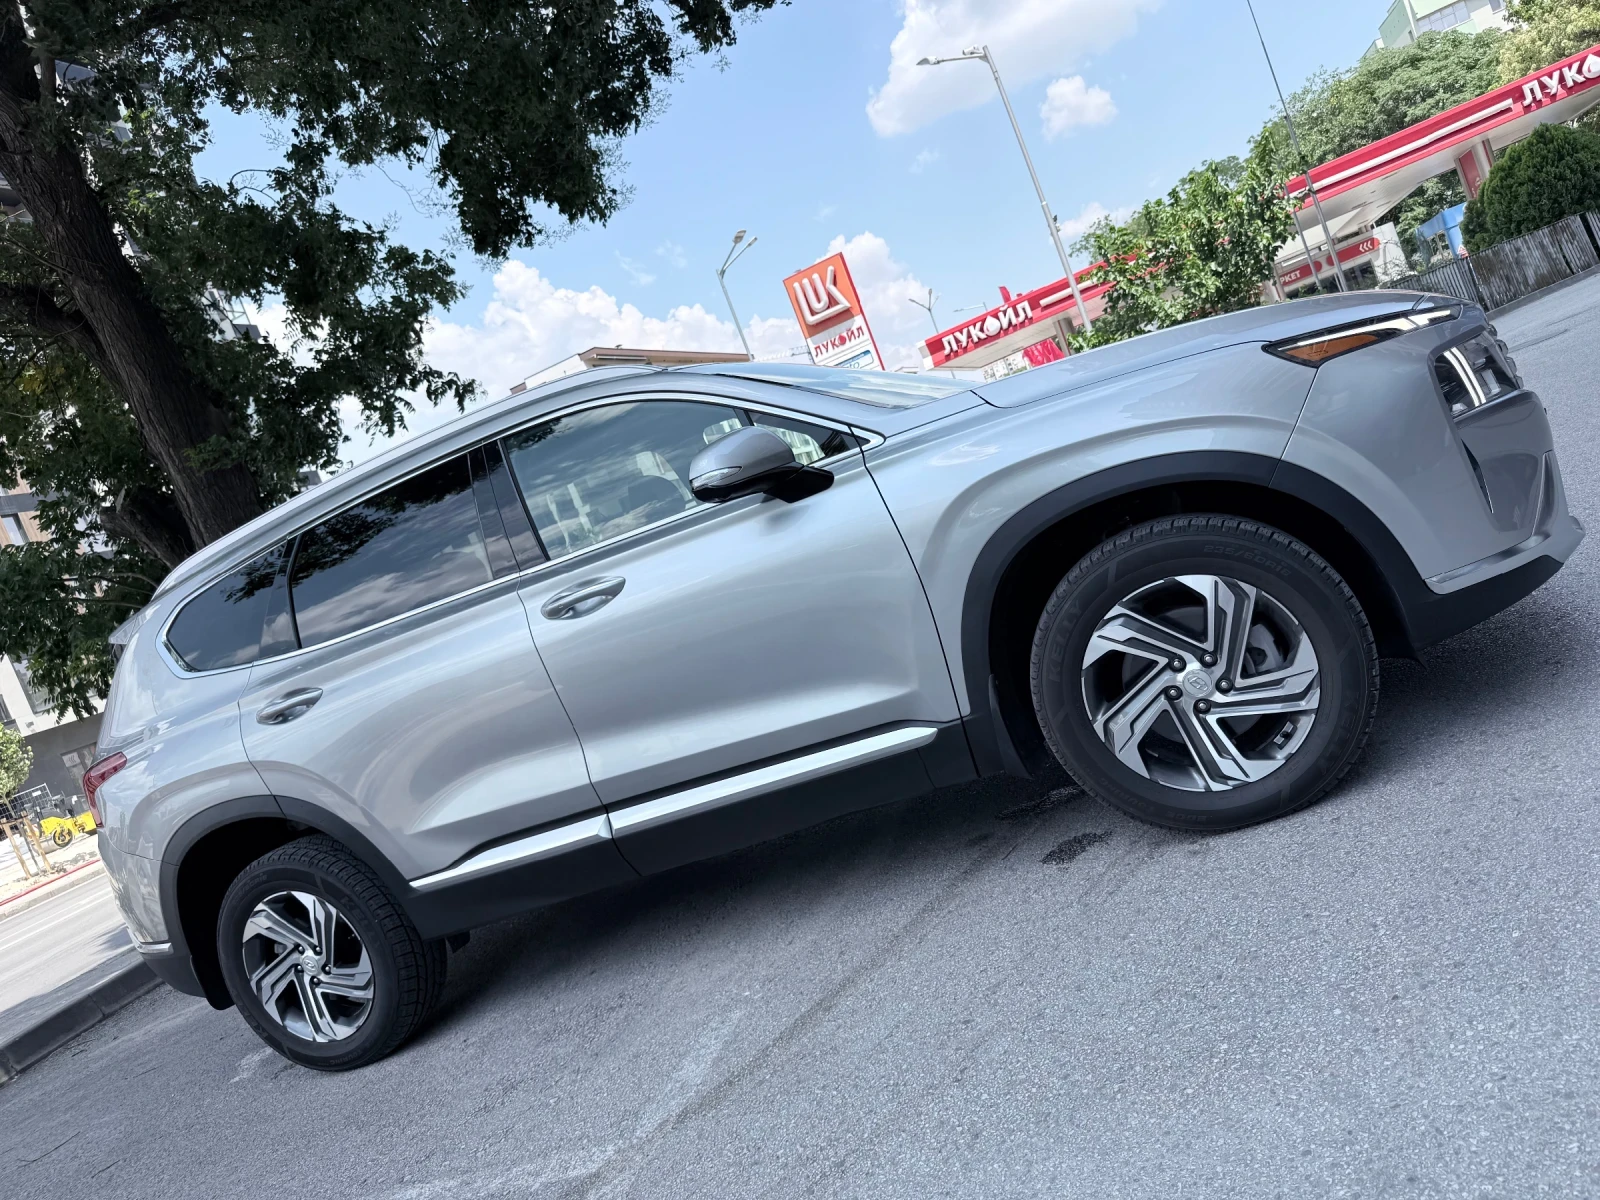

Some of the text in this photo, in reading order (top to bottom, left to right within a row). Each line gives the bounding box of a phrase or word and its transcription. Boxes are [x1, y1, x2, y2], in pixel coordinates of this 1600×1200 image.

[814, 325, 865, 357] ЛУКОЙЛ
[941, 300, 1033, 356] ЛУКОЙЛ
[1047, 599, 1082, 683] KELLY
